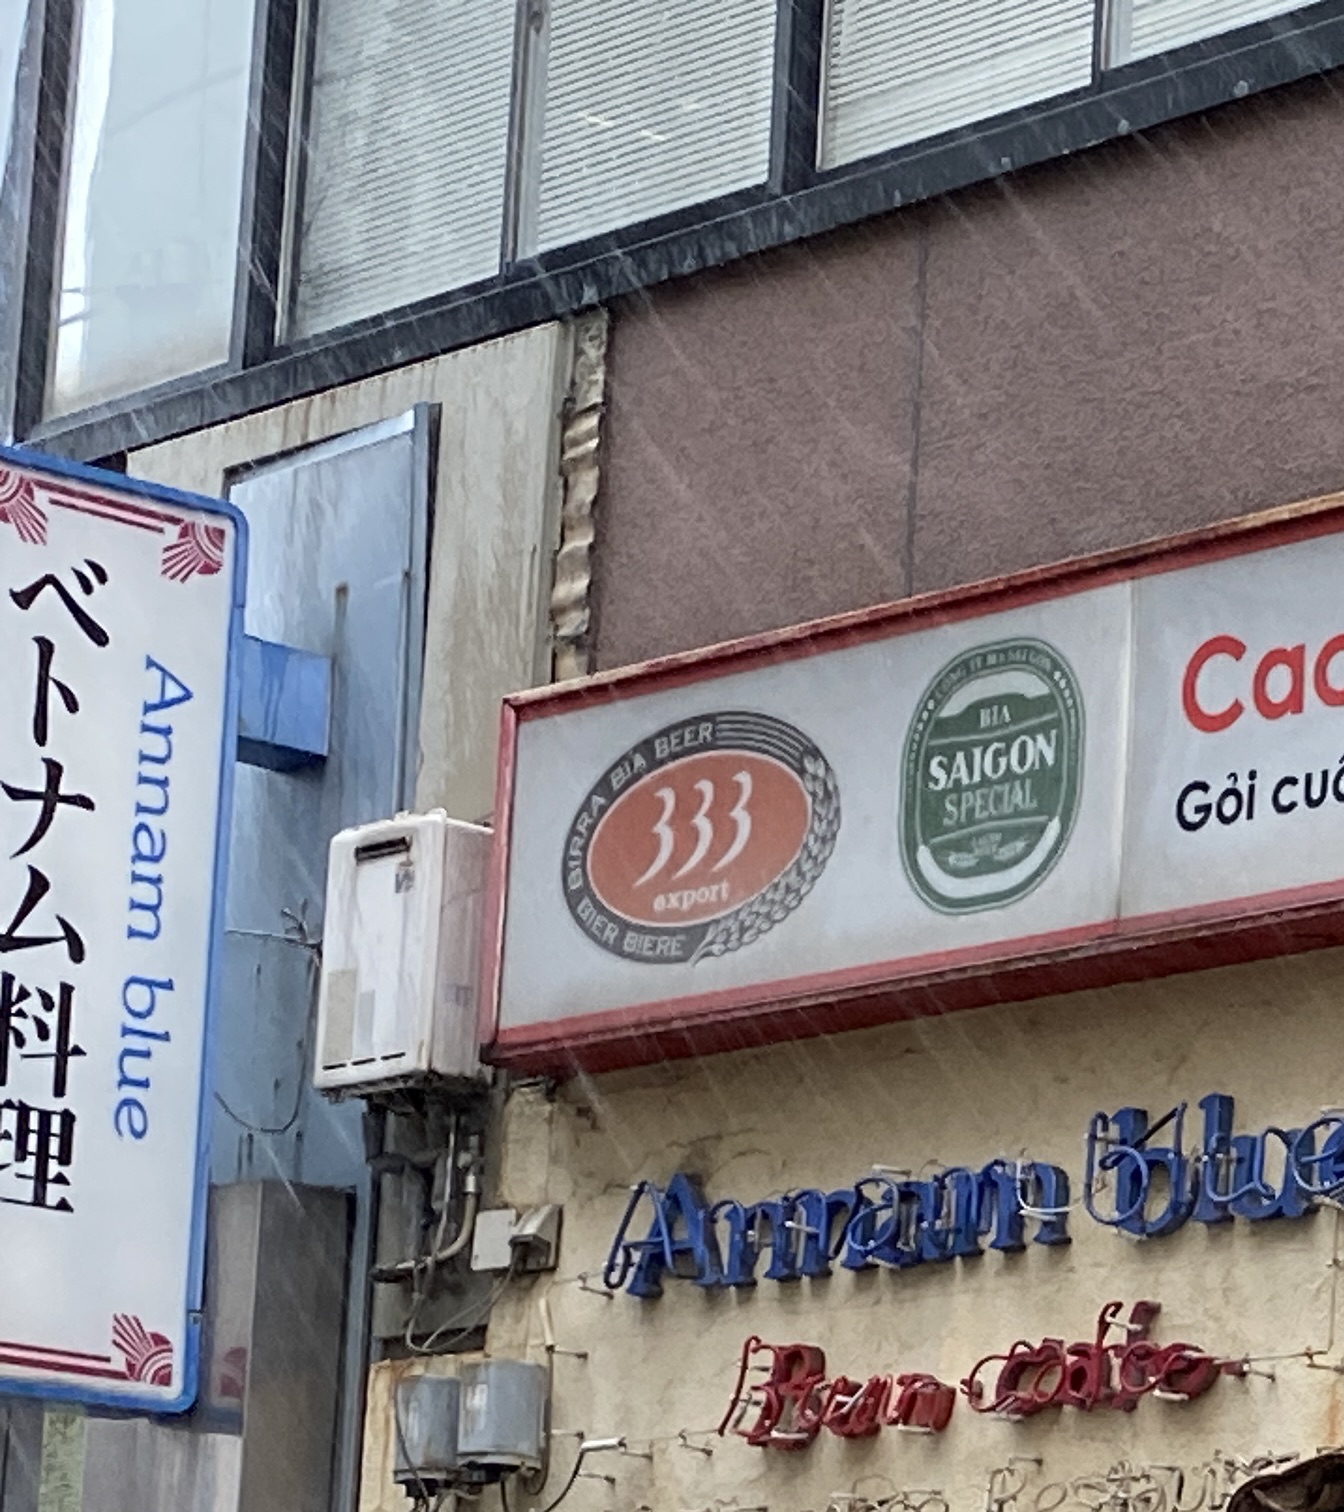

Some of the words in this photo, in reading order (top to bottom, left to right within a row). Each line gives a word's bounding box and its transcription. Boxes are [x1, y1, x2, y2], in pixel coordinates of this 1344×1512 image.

[126, 653, 194, 942] Annam
[567, 793, 607, 890] BIRRA
[653, 721, 715, 760] BEER
[927, 728, 1058, 792] SAIGON
[942, 784, 1039, 828] SPECIAL
[1175, 768, 1258, 833] Gỏi
[0, 558, 111, 1214] ベトナム料理
[633, 769, 753, 889] 333
[576, 898, 619, 947] BIER
[652, 879, 731, 913] export
[113, 973, 176, 1141] blue
[604, 1166, 1073, 1299] Annam
